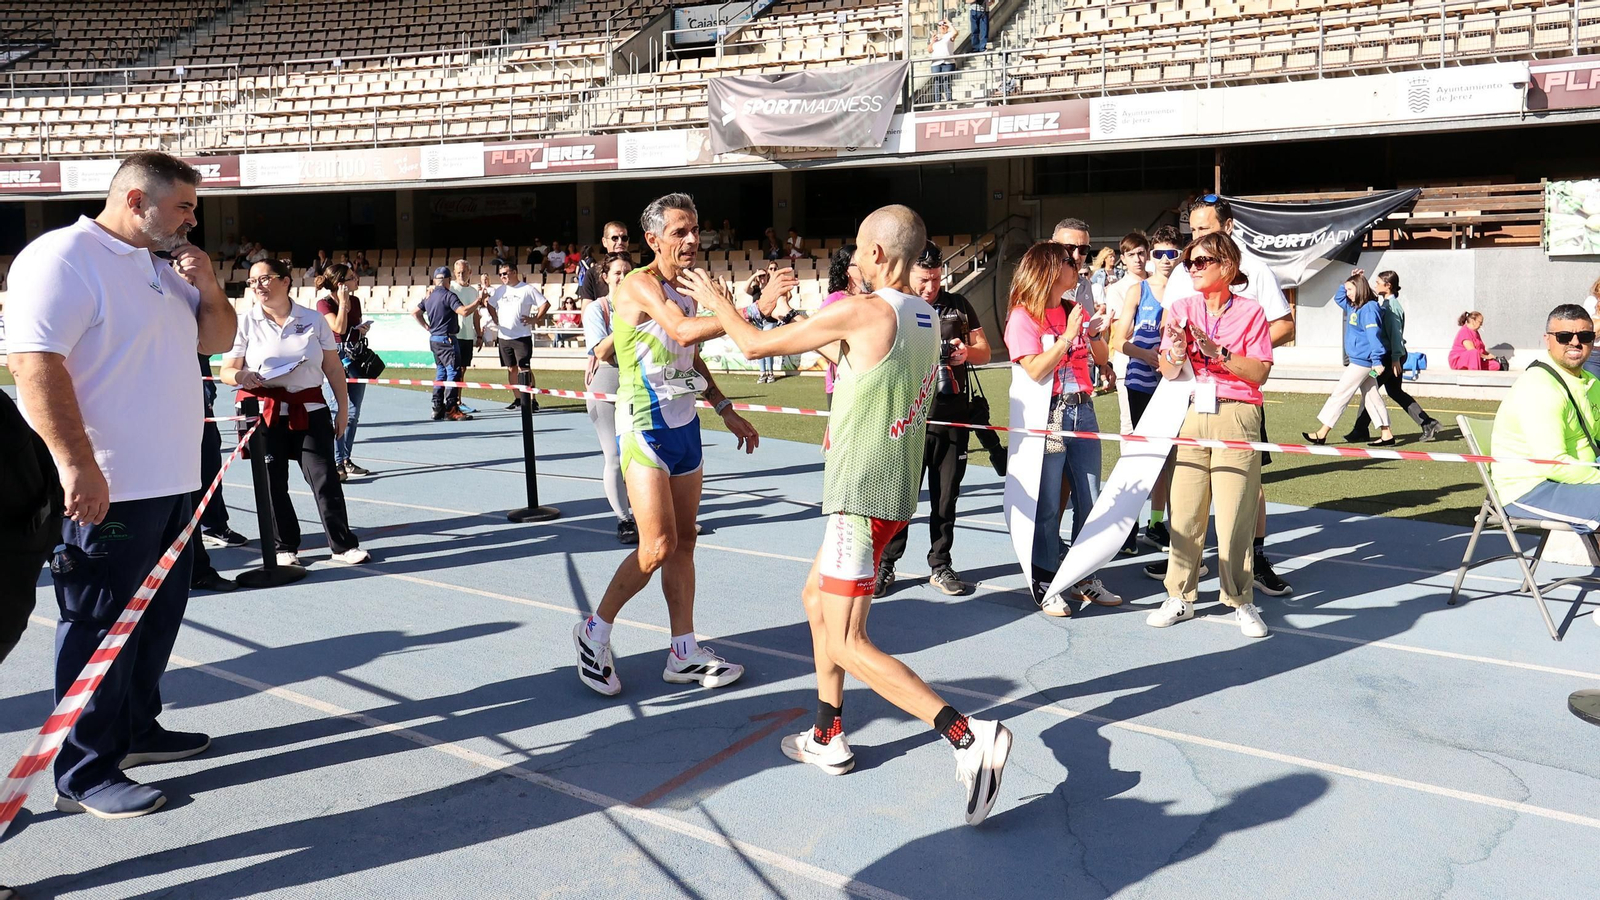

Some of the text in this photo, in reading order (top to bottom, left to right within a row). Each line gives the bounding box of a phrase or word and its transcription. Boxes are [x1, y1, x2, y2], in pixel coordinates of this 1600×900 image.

[1436, 83, 1503, 95] Ayuntamiento
[1450, 93, 1473, 103] Jerez
[741, 95, 883, 115] SPORTMADNESS
[684, 378, 696, 390] 5
[836, 510, 846, 569] marato
